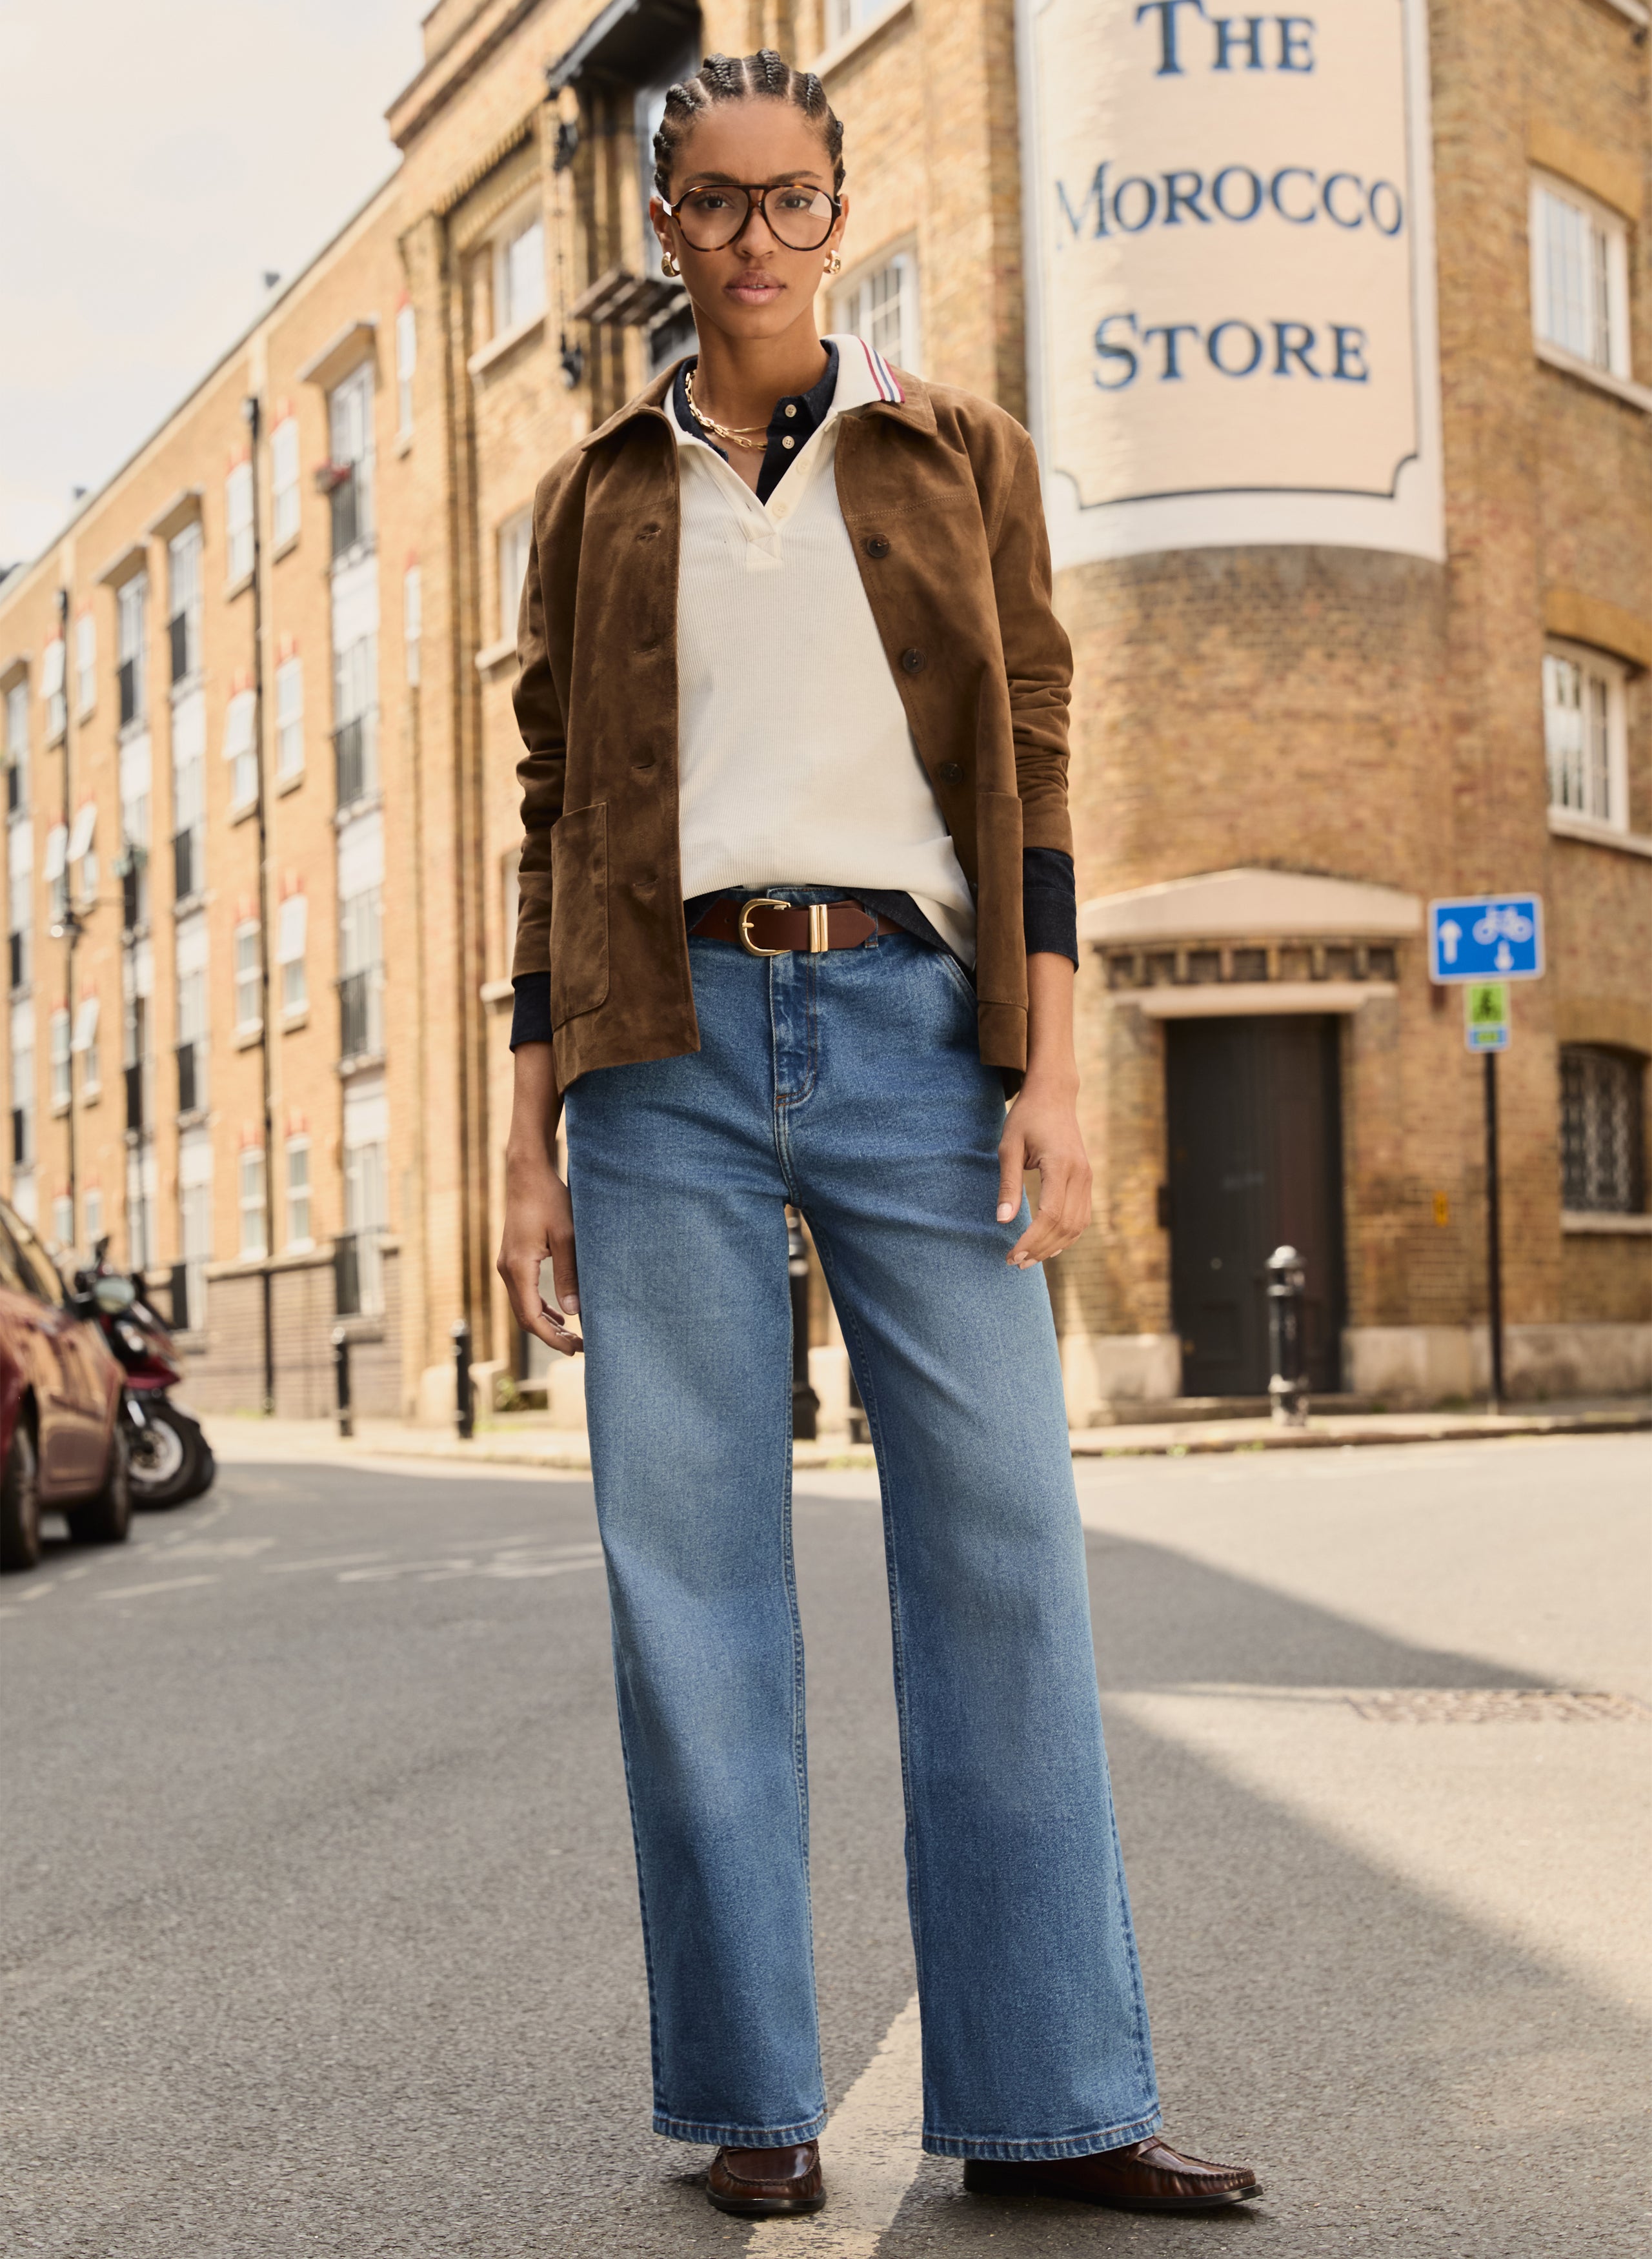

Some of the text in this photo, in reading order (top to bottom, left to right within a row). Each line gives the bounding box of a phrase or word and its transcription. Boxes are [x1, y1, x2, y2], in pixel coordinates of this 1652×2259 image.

[1134, 0, 1316, 77] THE
[1056, 161, 1403, 248] MOROCCO
[1094, 312, 1369, 390] STORE
